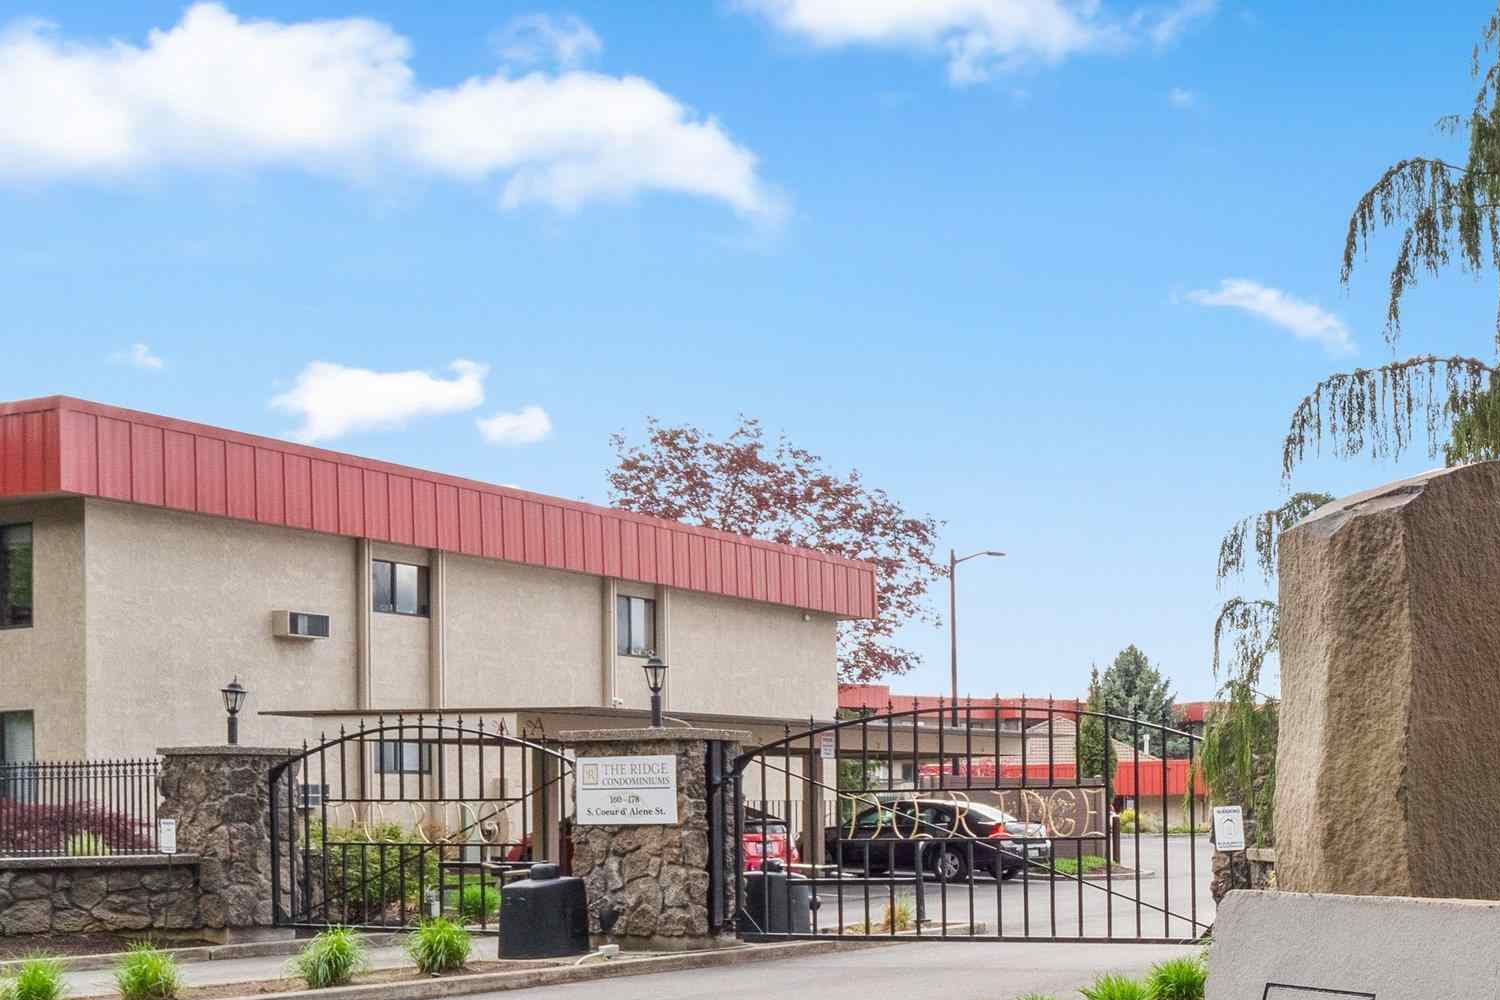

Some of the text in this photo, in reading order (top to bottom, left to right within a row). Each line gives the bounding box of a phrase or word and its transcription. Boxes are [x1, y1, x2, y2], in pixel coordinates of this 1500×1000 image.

[601, 763, 669, 775] THE RIDGE
[601, 776, 671, 786] CONDOMINIUMS
[586, 808, 593, 816] S.
[595, 808, 619, 816] Coeur
[654, 807, 666, 816] St.
